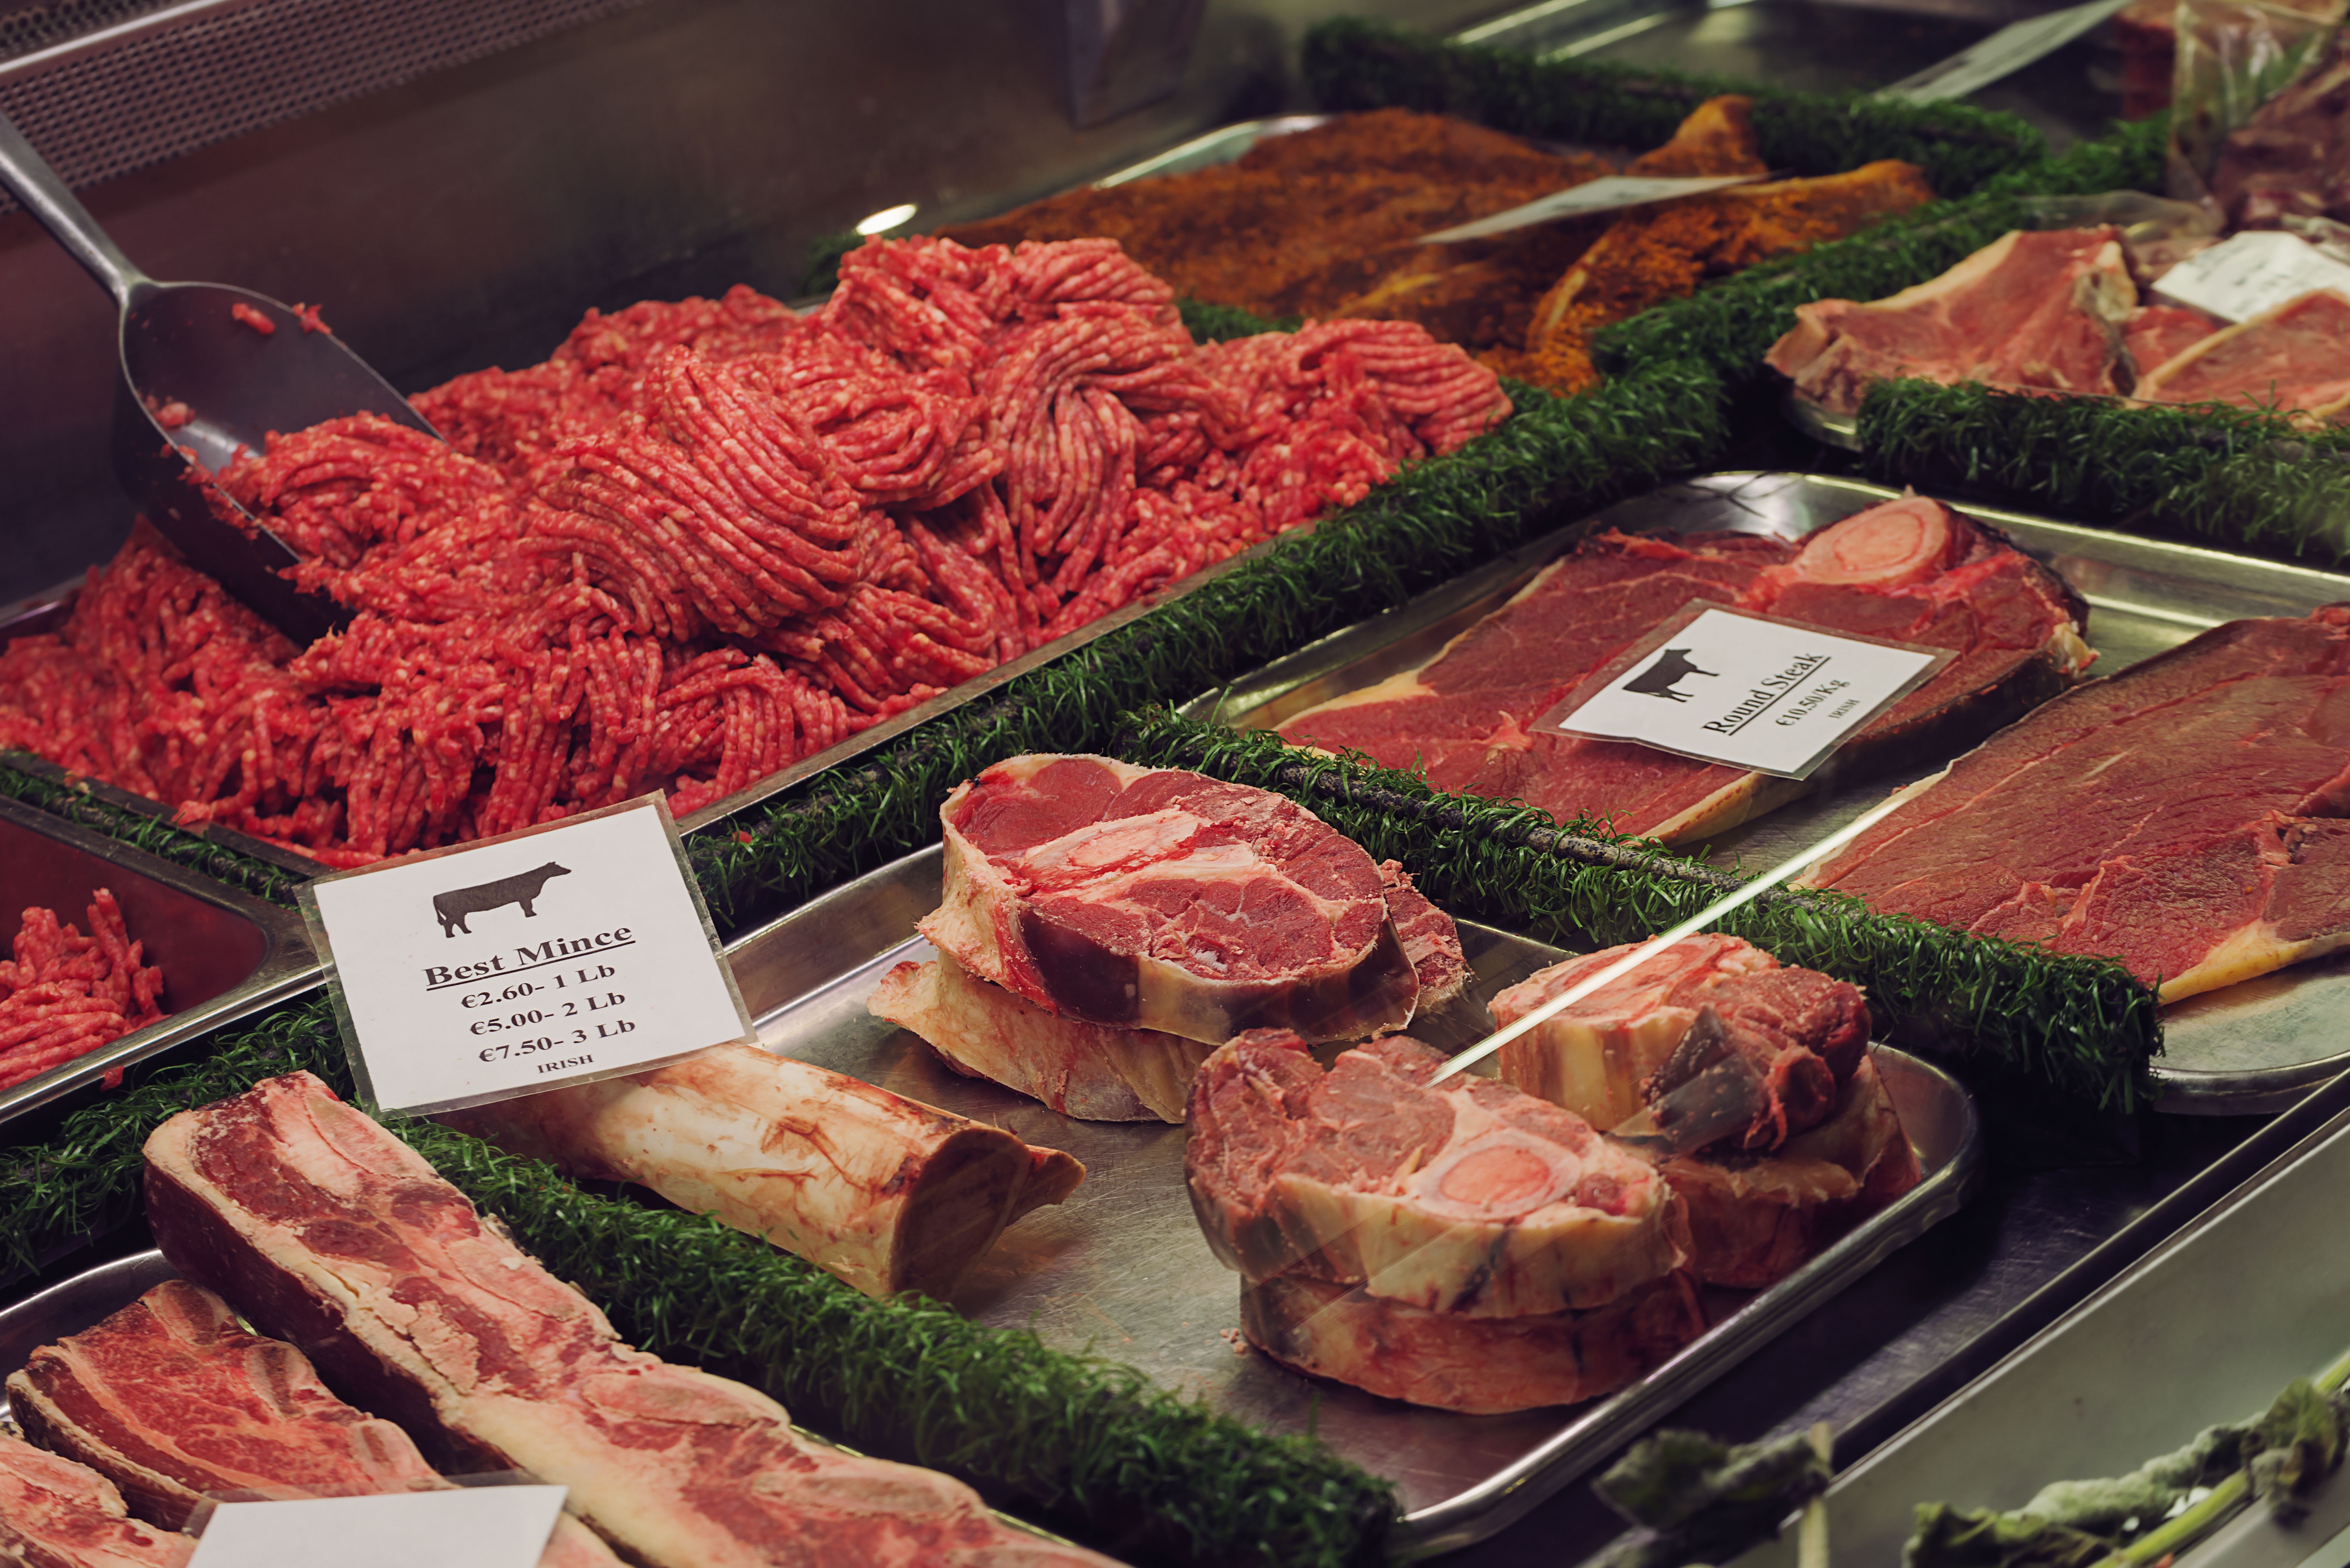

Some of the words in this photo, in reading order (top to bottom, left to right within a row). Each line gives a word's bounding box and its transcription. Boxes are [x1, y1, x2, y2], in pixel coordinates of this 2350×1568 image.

[1701, 689, 1775, 734] Round
[1761, 653, 1823, 690] Steak
[1776, 679, 1850, 726] €10.50/Kg
[1828, 699, 1860, 719] IRISH
[422, 955, 506, 987] Best
[514, 927, 632, 966] Mince
[553, 975, 567, 989] 1
[575, 964, 616, 984] Lb
[562, 1002, 578, 1017] 2
[585, 992, 626, 1011] Lb
[571, 1029, 587, 1044] 3
[595, 1019, 636, 1038] Lb
[537, 1054, 595, 1074] IRISH
